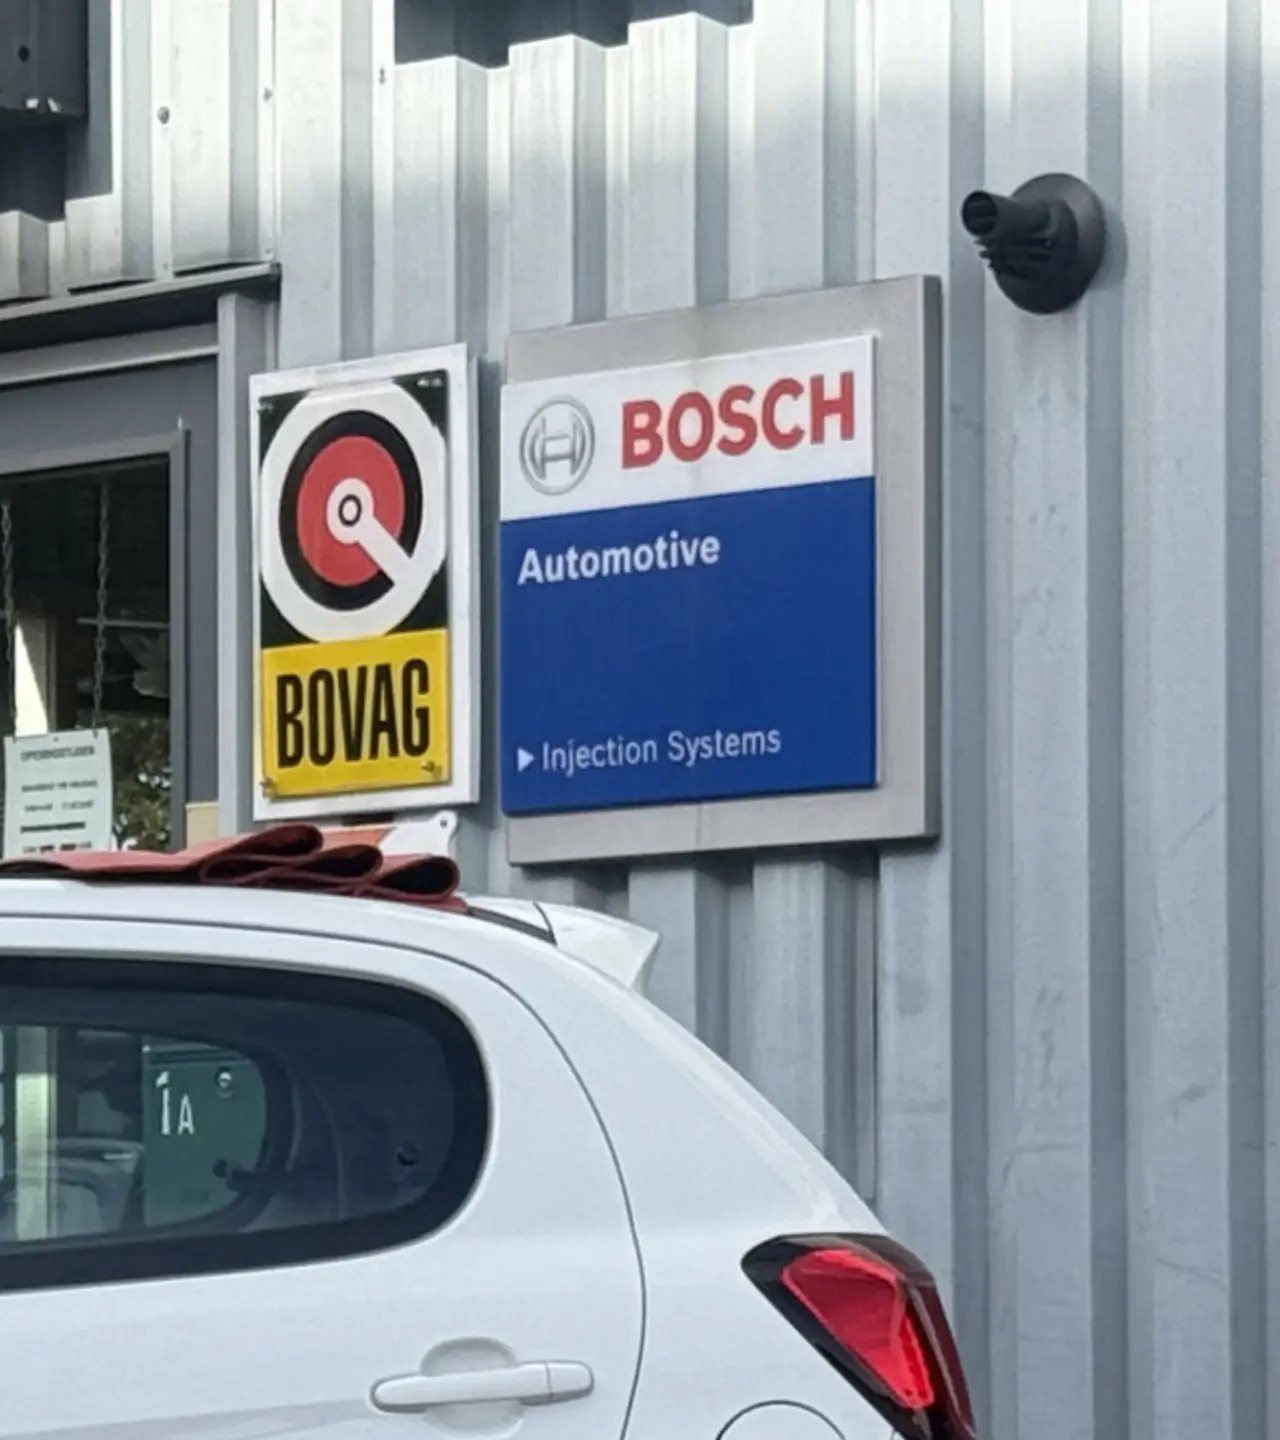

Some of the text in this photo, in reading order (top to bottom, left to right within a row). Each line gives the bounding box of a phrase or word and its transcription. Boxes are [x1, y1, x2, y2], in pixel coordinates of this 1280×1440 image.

[621, 371, 856, 470] BOSCH
[516, 530, 721, 586] Automotive
[275, 658, 430, 769] BOVAG
[542, 725, 782, 777] Injection Systems
